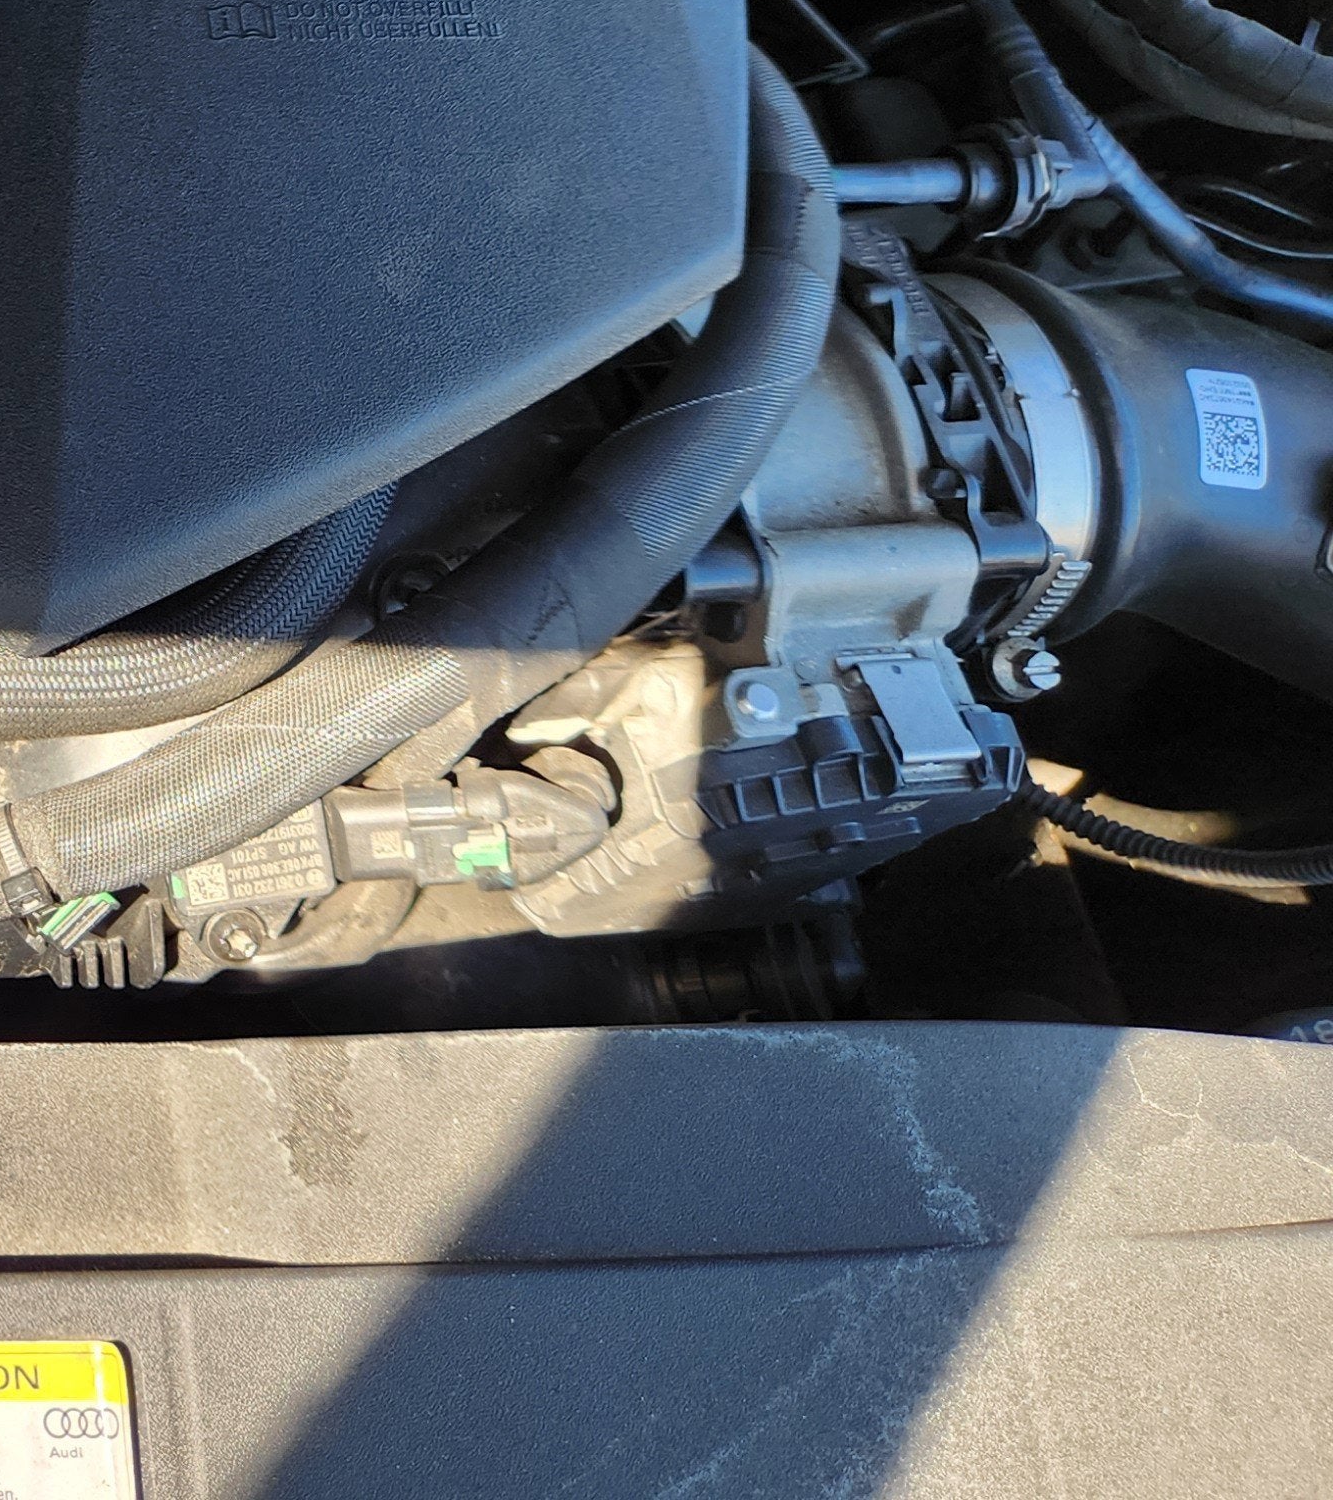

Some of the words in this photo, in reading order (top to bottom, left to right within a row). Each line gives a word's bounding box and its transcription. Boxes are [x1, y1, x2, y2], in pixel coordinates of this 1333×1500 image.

[277, 841, 297, 857] AG
[299, 838, 320, 854] VW
[49, 1446, 84, 1458] Audi
